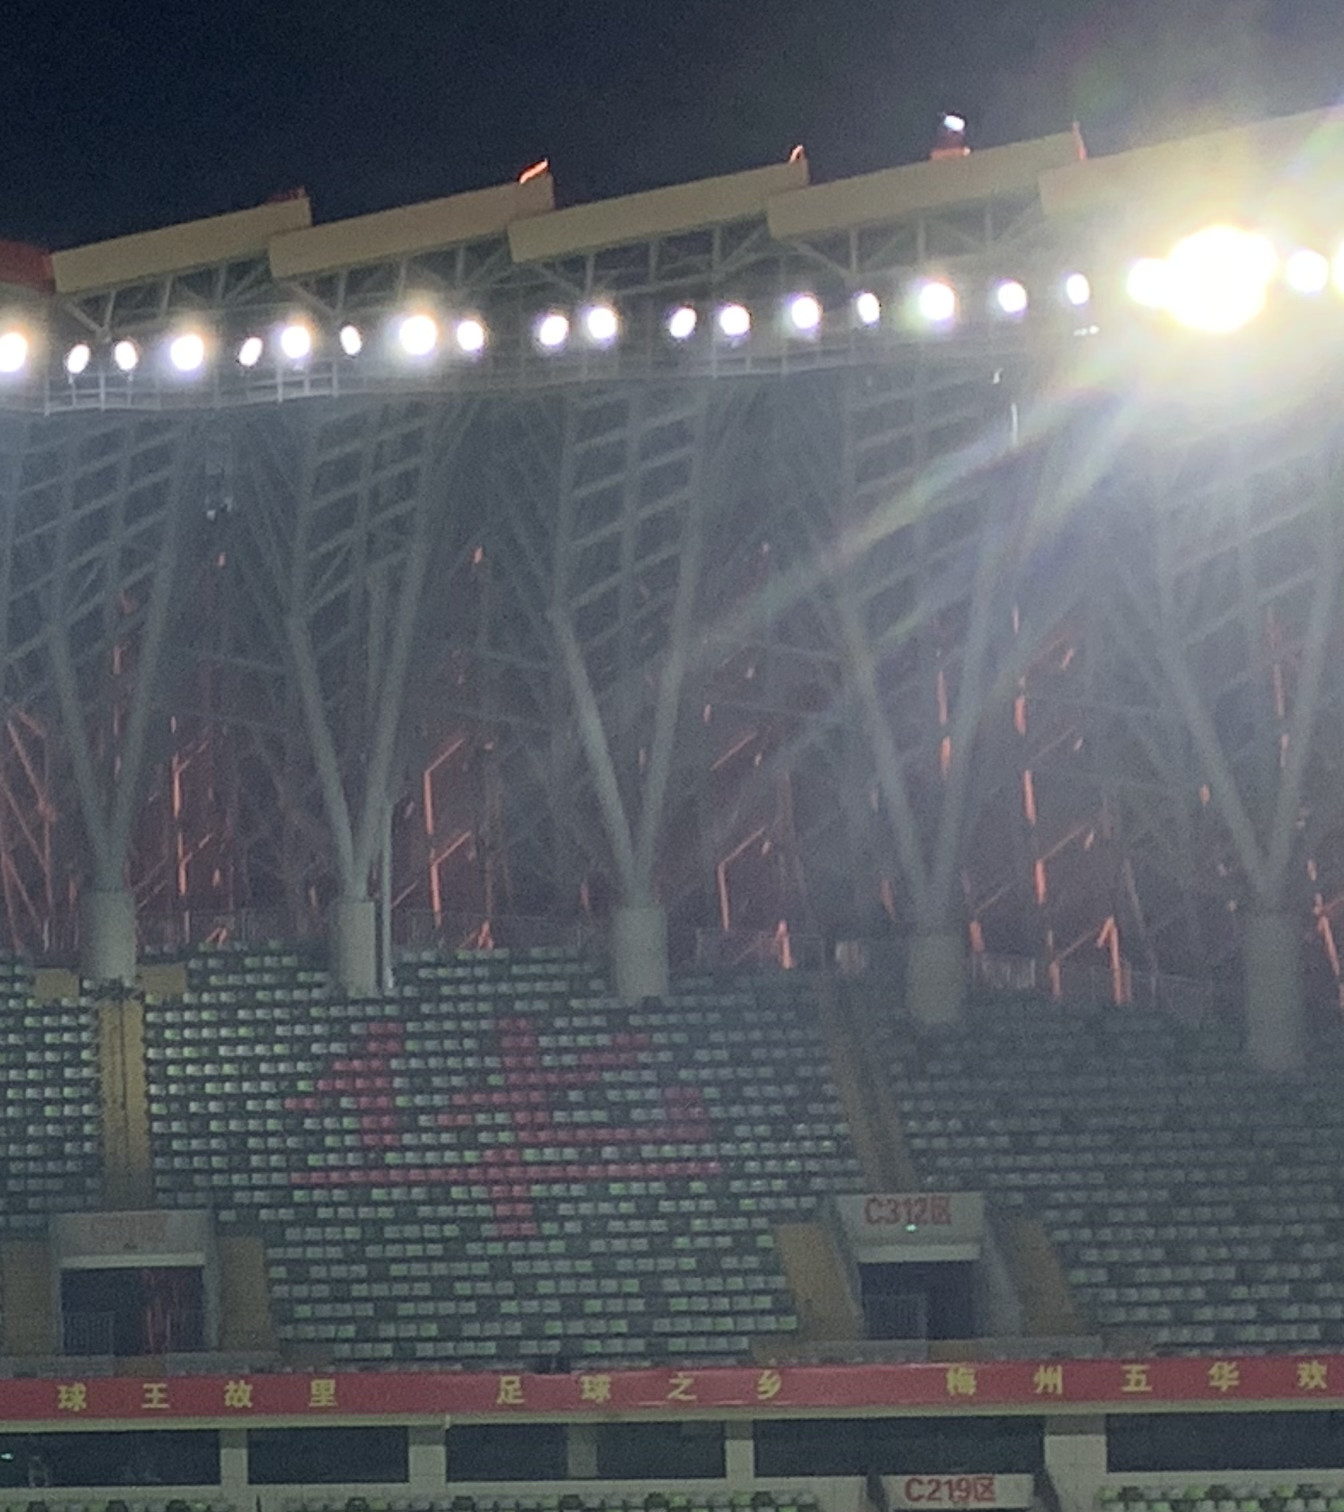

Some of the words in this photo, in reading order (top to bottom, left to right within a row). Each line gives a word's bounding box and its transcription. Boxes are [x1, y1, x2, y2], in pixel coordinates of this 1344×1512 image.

[58, 1380, 337, 1412] 球王故里
[497, 1370, 782, 1405] 足球之乡
[904, 1476, 996, 1501] C219区
